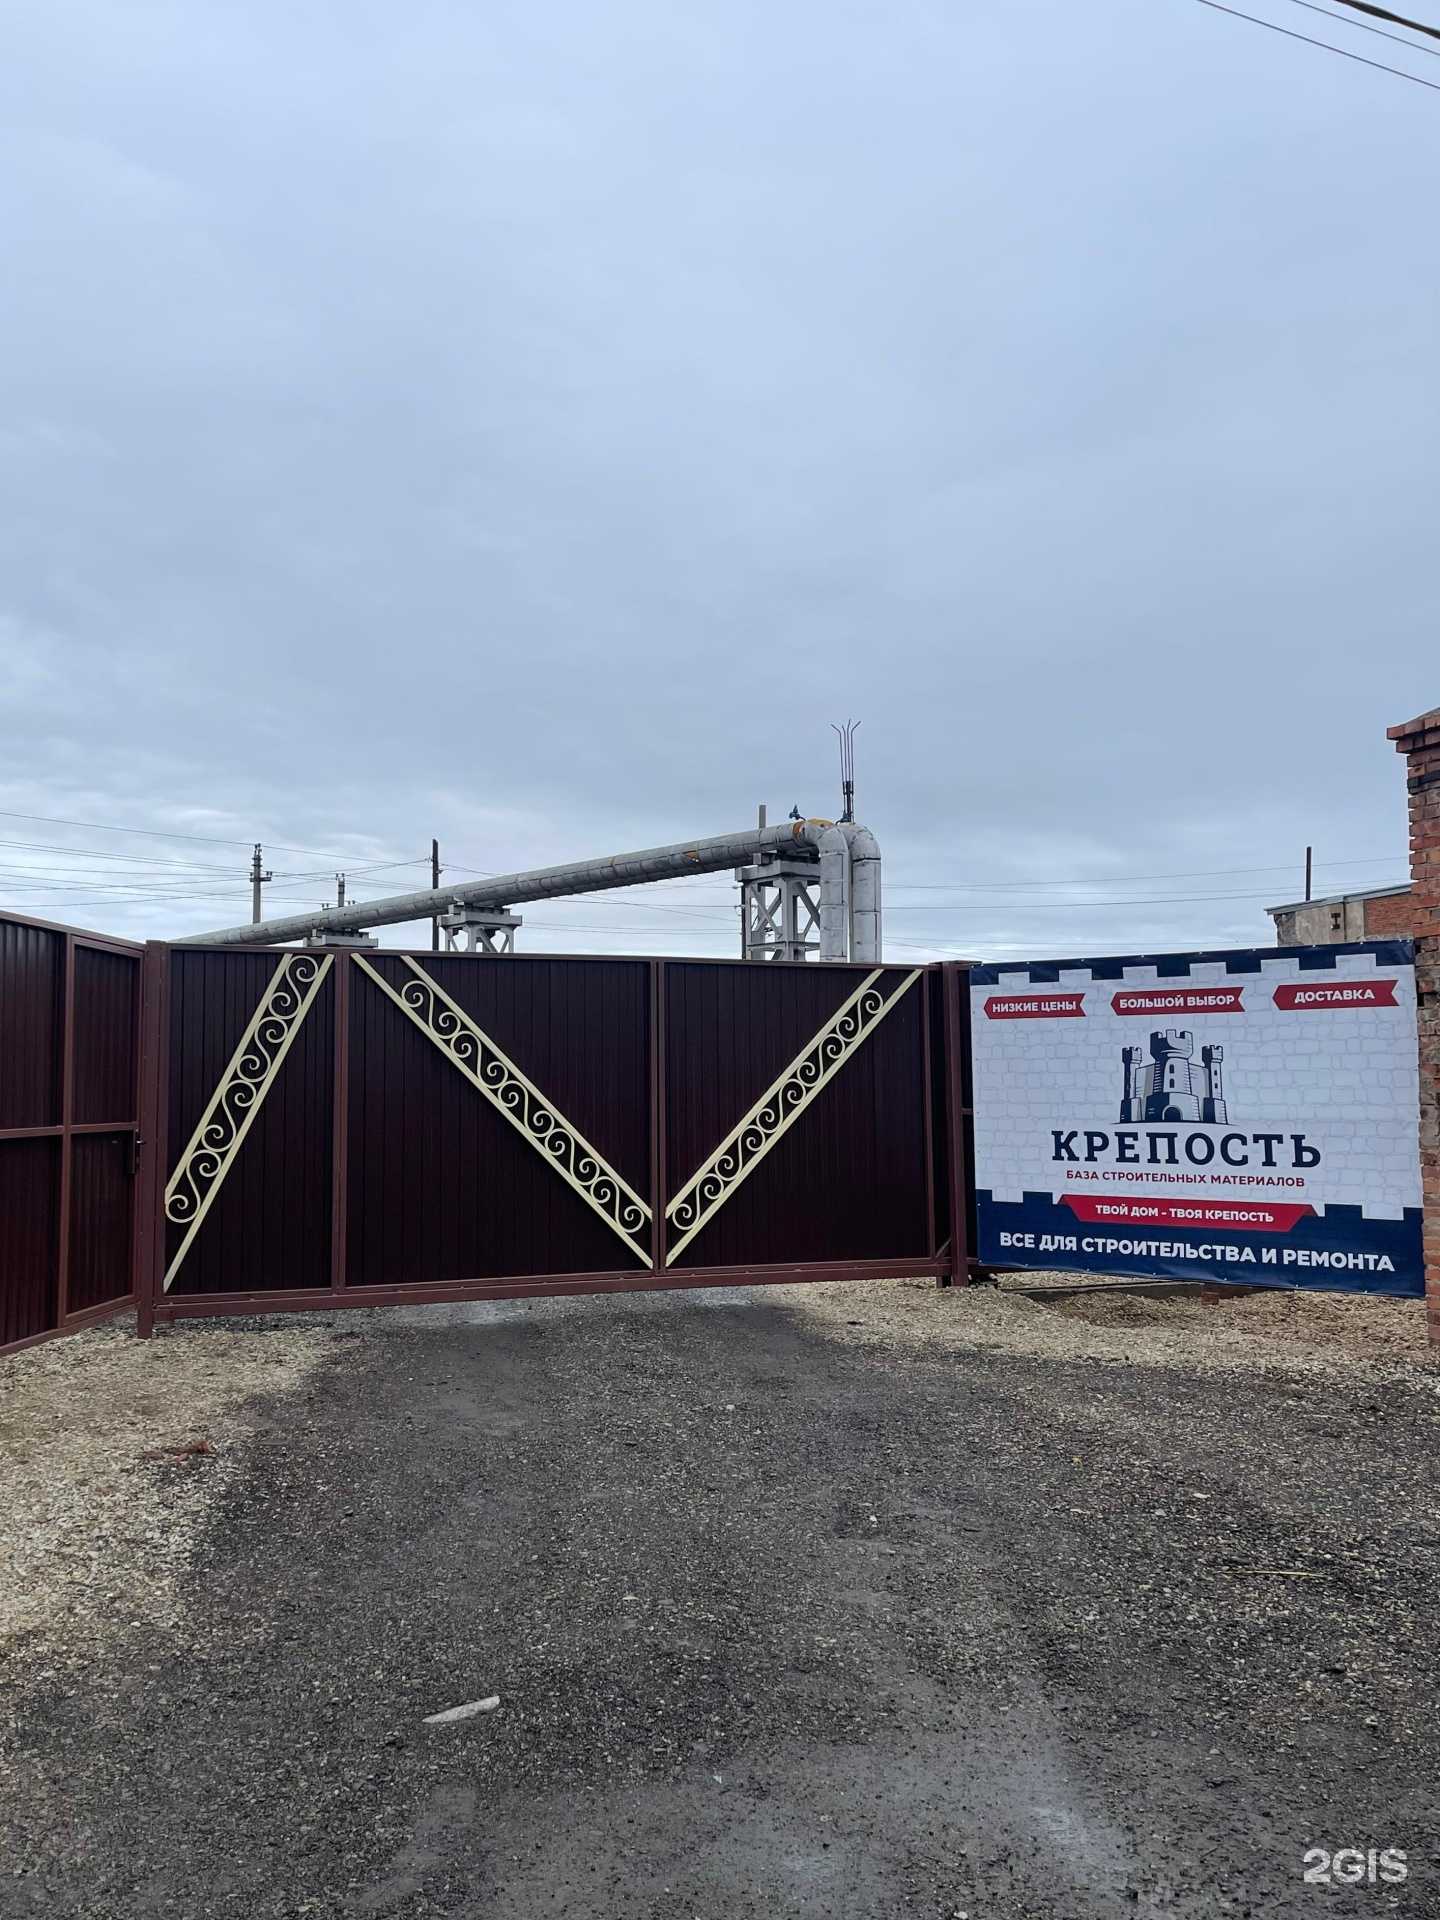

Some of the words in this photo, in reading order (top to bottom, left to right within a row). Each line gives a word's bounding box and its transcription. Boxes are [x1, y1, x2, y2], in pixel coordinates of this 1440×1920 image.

[1119, 995, 1184, 1008] БОЛЬШОЙ
[1187, 994, 1234, 1006] ВЫБОР
[1294, 989, 1375, 1003] ДОСТАВКА
[992, 1002, 1038, 1013] НИЗКИЕ
[1041, 1000, 1077, 1013] ЦЕНЫ
[1052, 1130, 1321, 1168] КРЕПОСТЬ
[1066, 1170, 1099, 1180] БАЗА
[1102, 1171, 1206, 1184] СТРОИТЕЛЬНЫХ
[1210, 1175, 1304, 1187] МАТЕРИАЛОВ
[1095, 1204, 1128, 1217] ТВОЙ
[1131, 1206, 1158, 1218] ДОМ
[1169, 1208, 1202, 1219] ТВОЯ
[1205, 1209, 1274, 1223] КРЕПОСТЬ
[1000, 1232, 1036, 1248] ВСЕ
[1039, 1235, 1078, 1252] ДЛЯ
[1082, 1237, 1256, 1263] СТРОИТЕЛЬСТВА
[1262, 1248, 1277, 1263] И
[1283, 1249, 1395, 1272] РЕМОНТА
